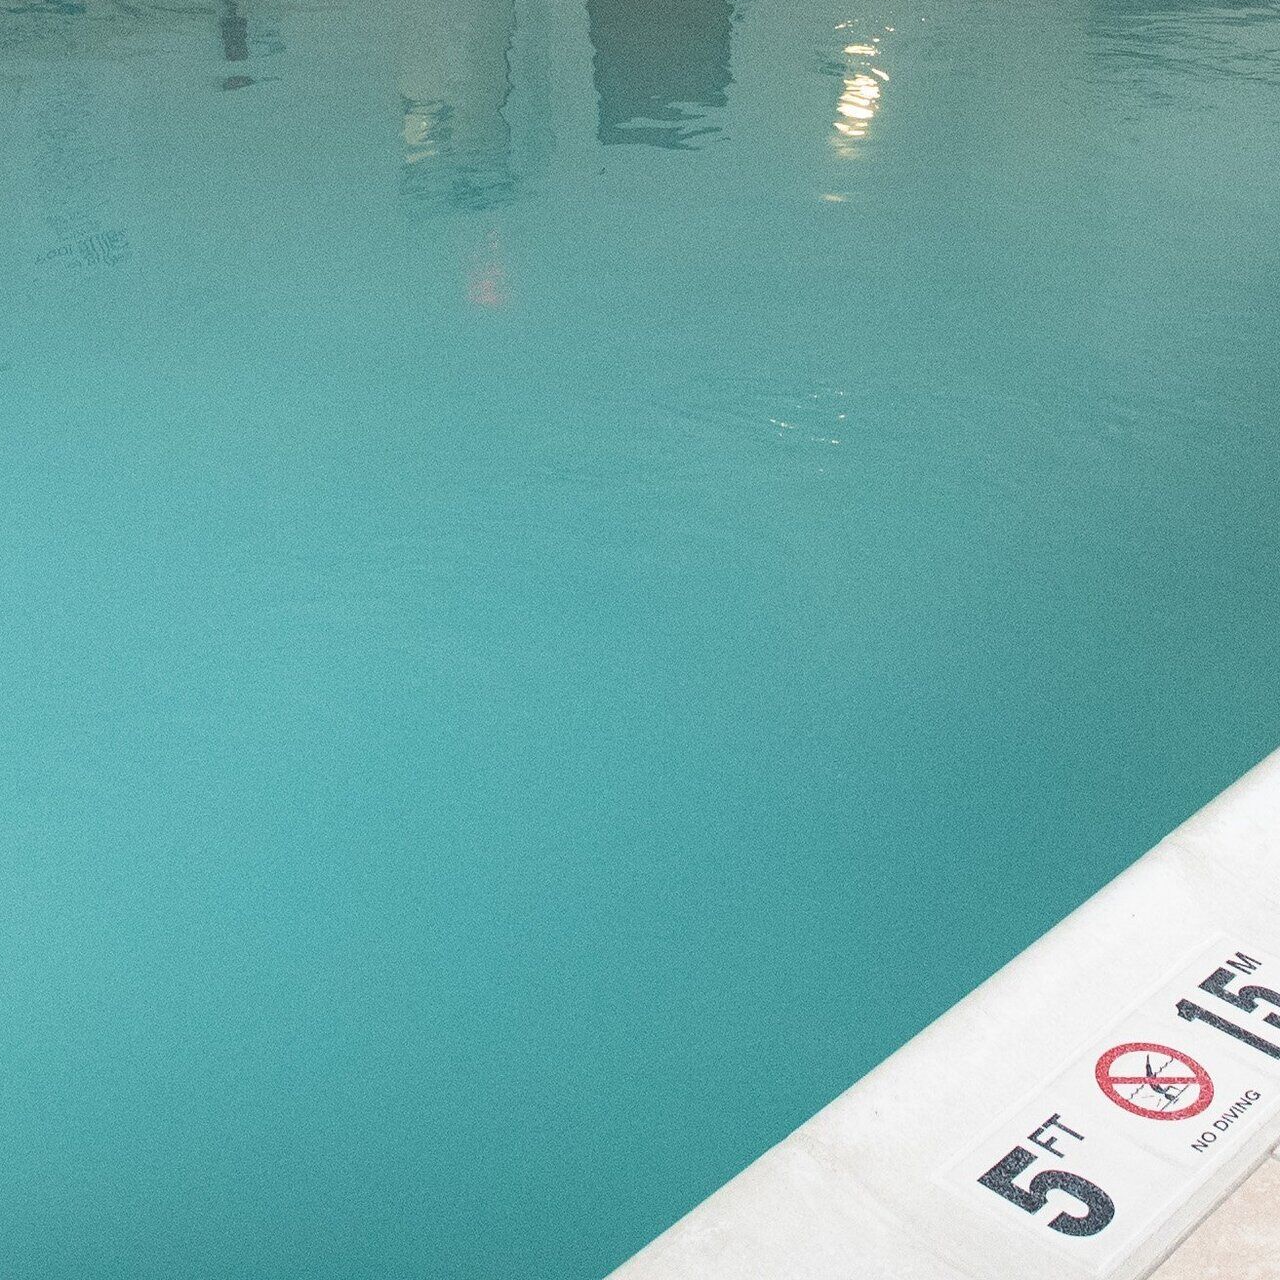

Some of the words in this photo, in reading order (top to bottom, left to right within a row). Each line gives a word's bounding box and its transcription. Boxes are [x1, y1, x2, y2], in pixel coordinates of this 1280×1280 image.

[1226, 951, 1262, 976] M
[1027, 1112, 1086, 1158] FT
[1189, 1130, 1218, 1154] NO
[1215, 1089, 1262, 1132] DIVING
[976, 1144, 1116, 1237] 5
